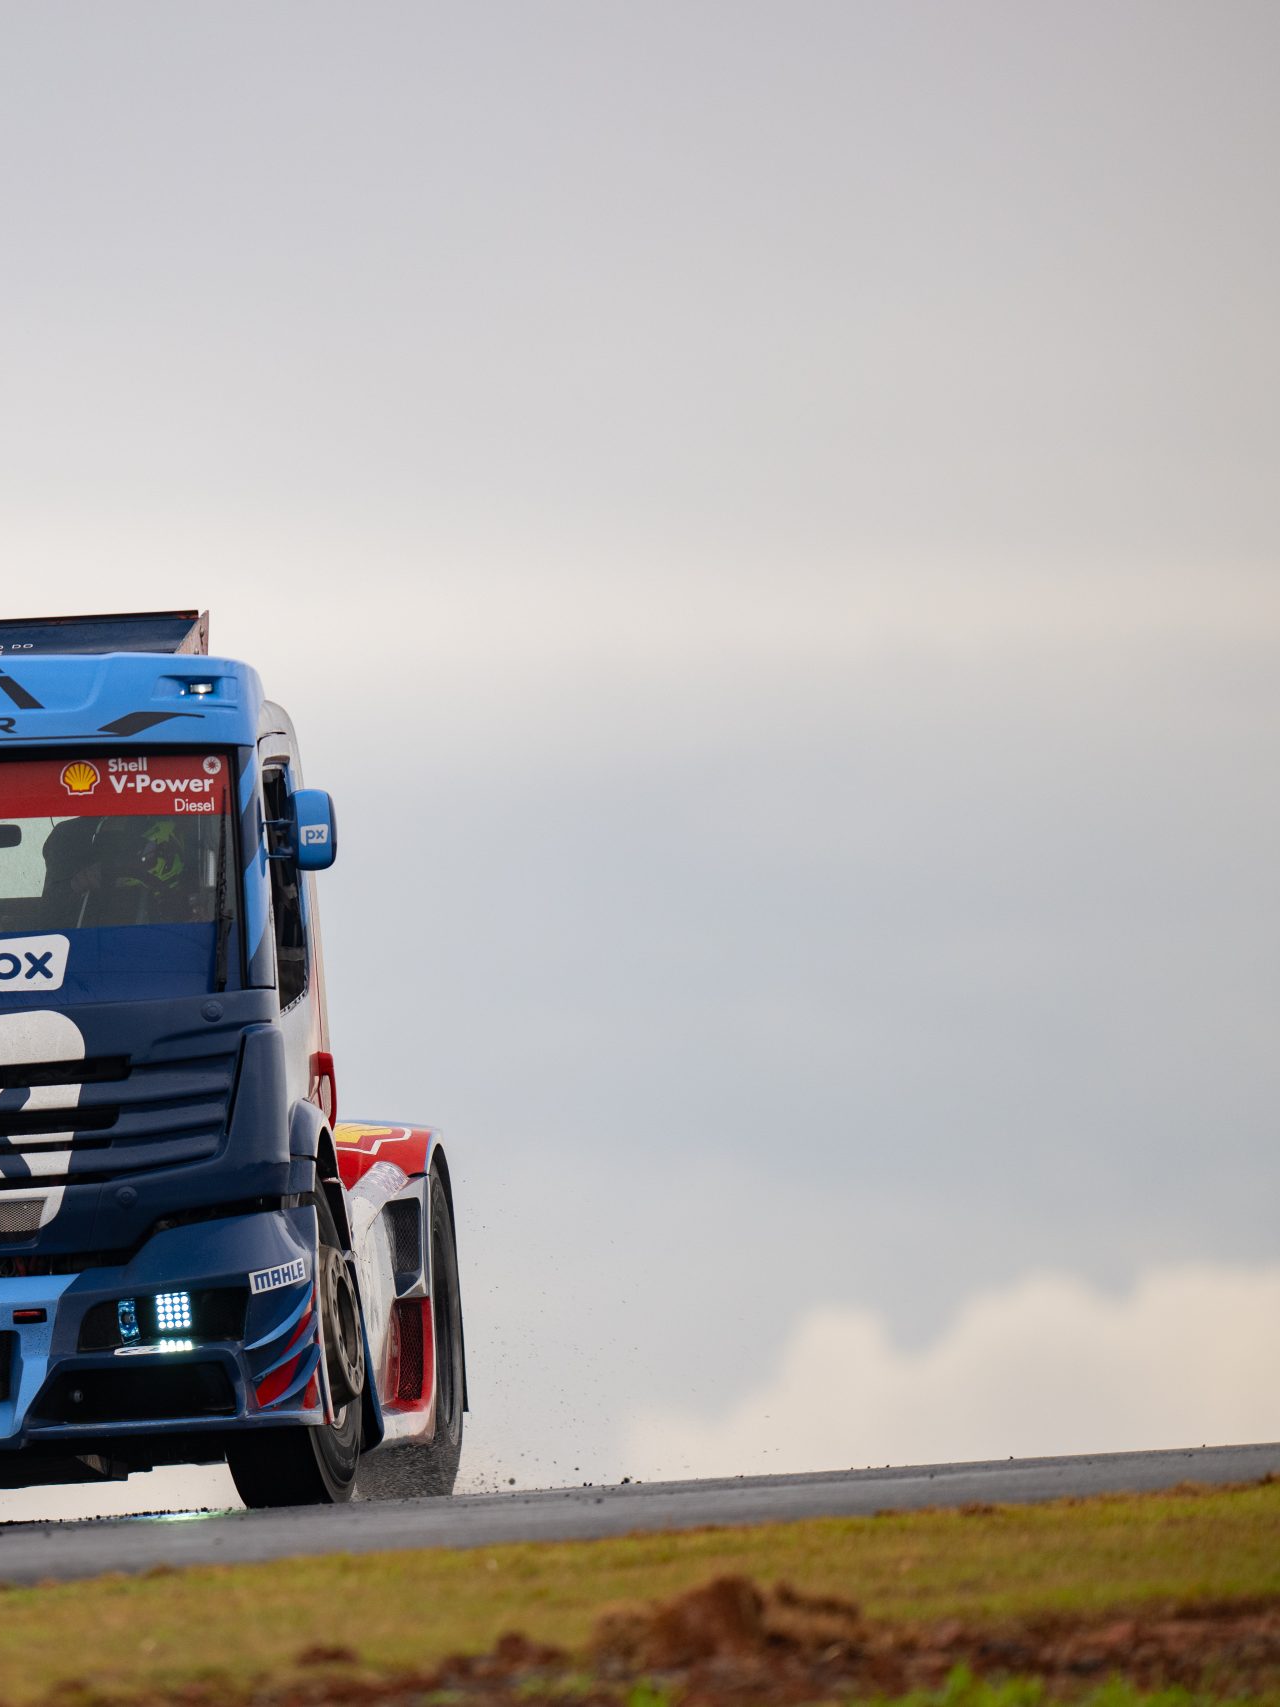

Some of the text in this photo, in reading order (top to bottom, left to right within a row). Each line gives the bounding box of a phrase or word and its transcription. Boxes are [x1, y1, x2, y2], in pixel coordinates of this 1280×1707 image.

[108, 757, 147, 772] Shell
[109, 774, 214, 794] V-Power
[174, 798, 215, 812] Diesel
[305, 830, 324, 843] px
[254, 1262, 304, 1290] MAHLE
